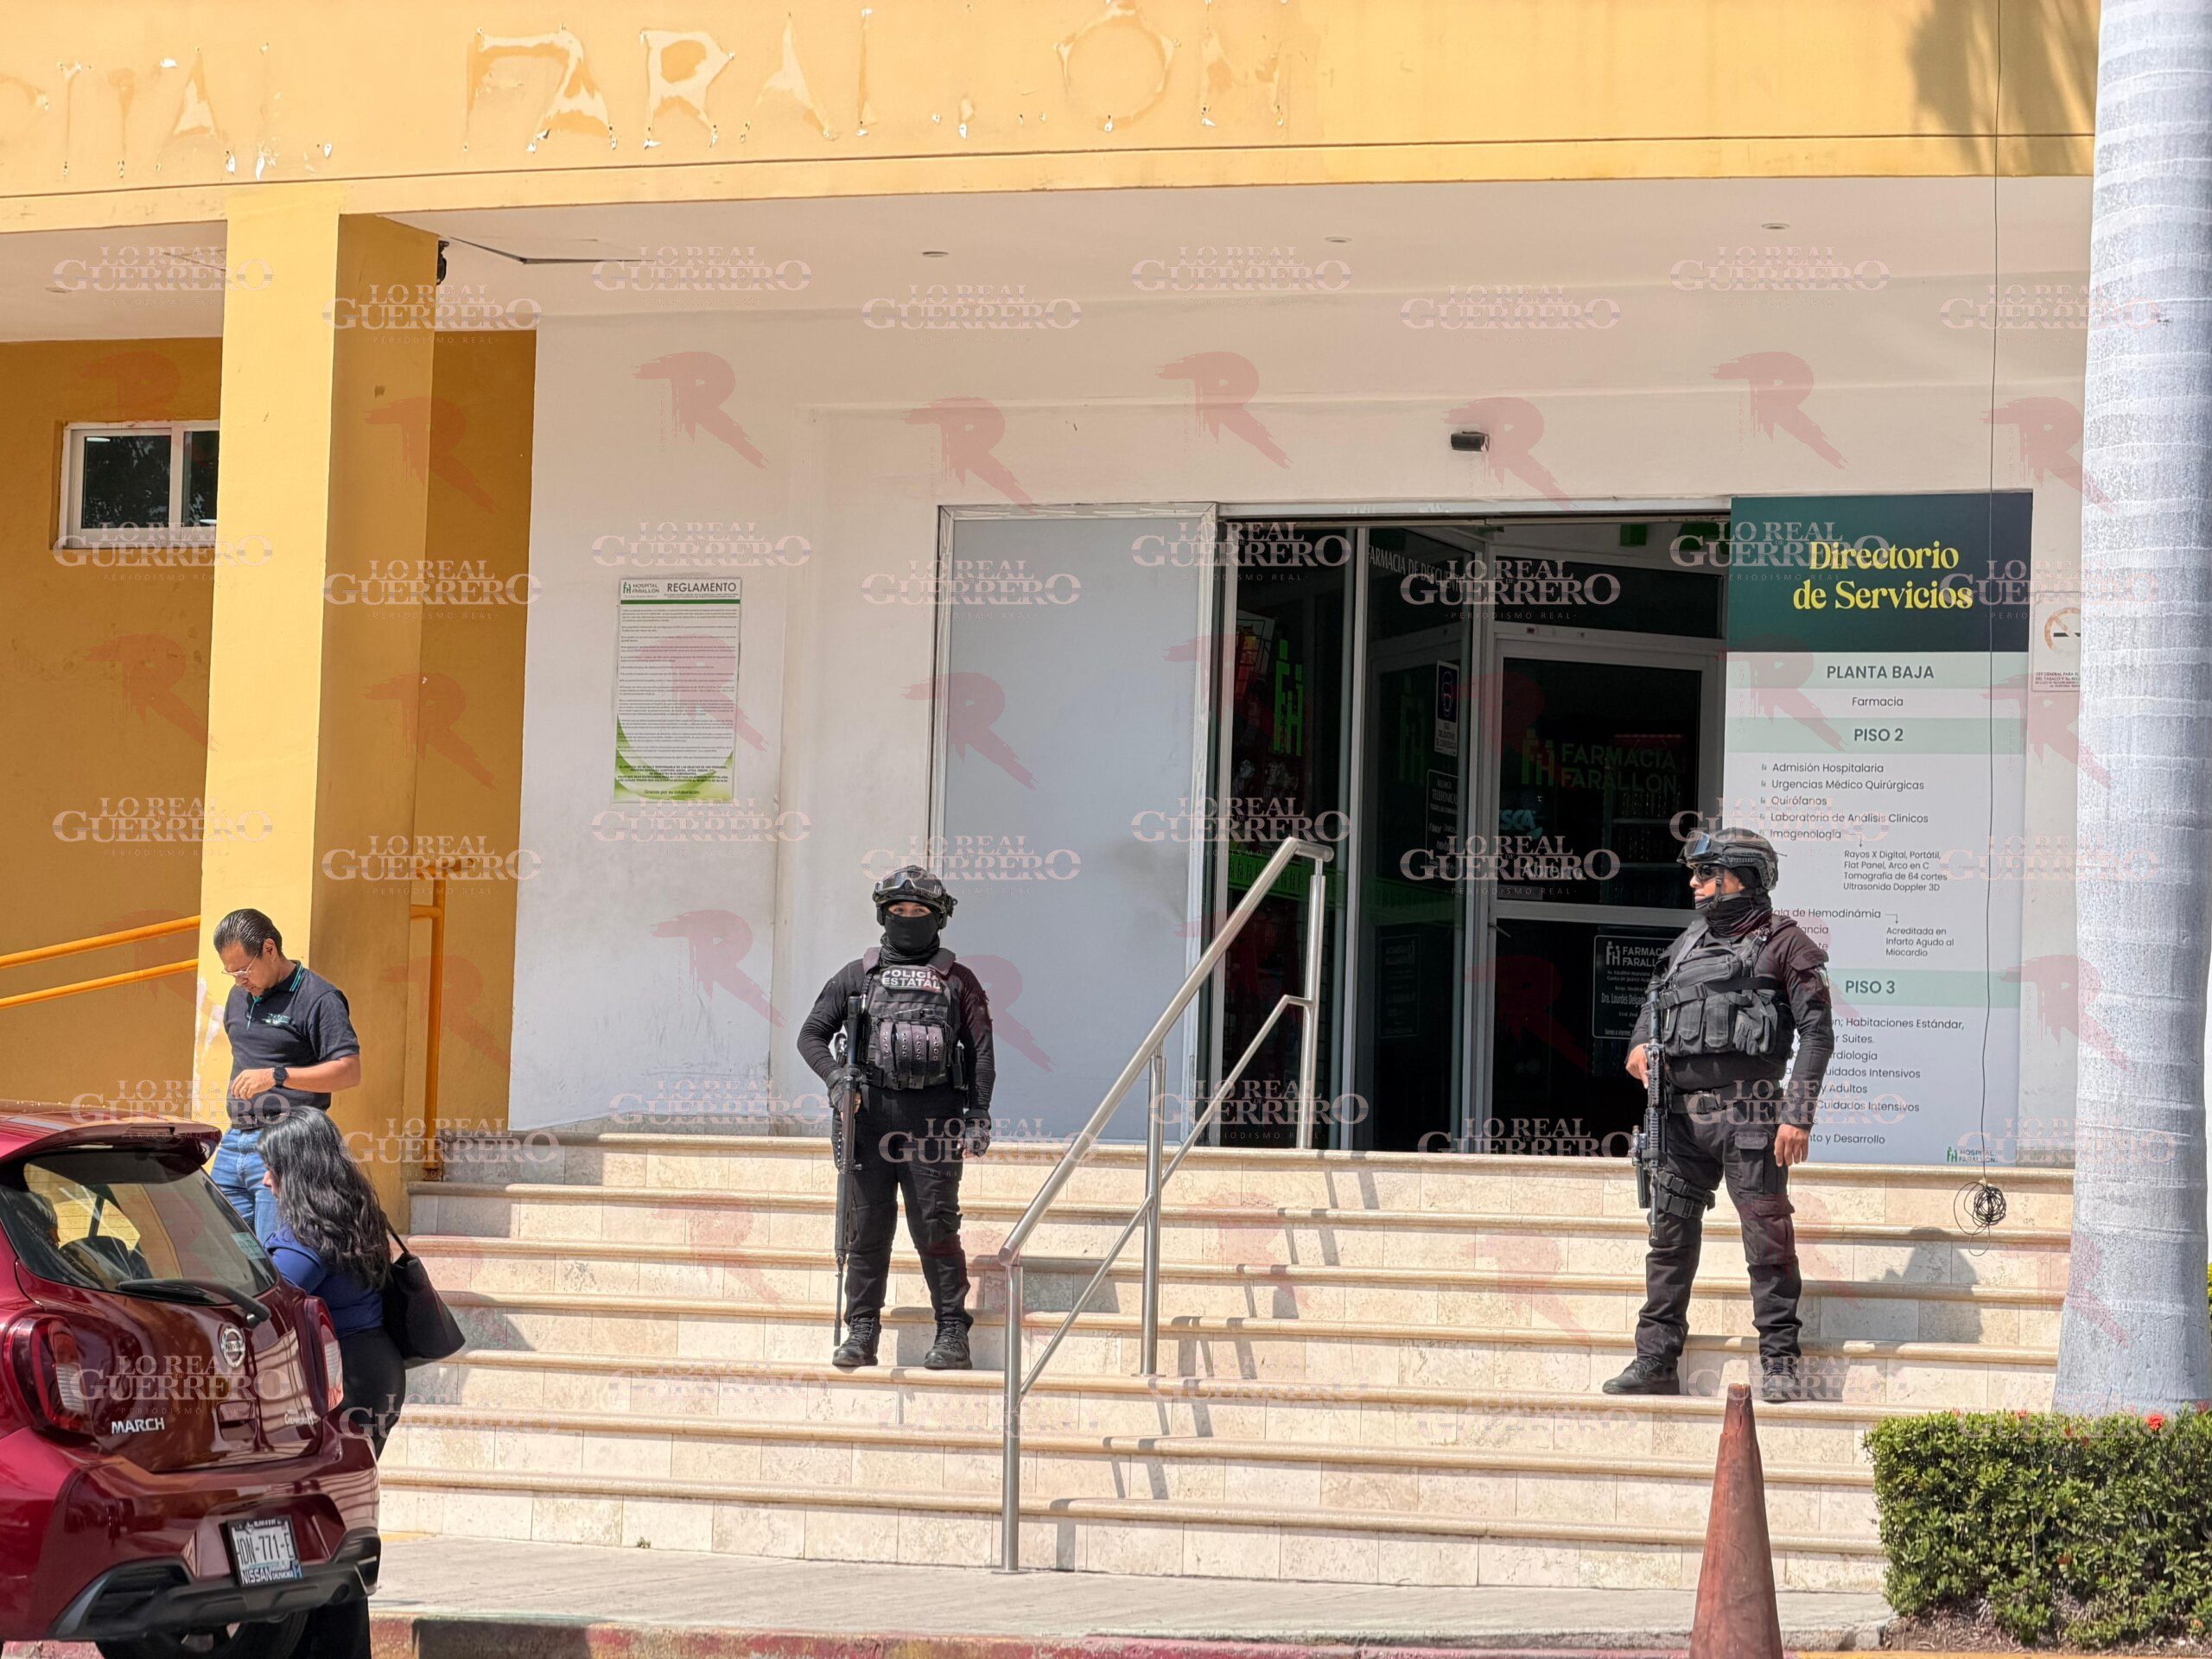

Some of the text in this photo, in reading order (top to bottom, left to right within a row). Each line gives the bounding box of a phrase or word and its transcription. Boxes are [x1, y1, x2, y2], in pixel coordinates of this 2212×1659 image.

[1809, 540, 1960, 569] Directorio
[666, 582, 737, 594] REGLAMENTO
[1793, 579, 1974, 609] de Servicios
[1827, 665, 1935, 679] PLANTA BAJA
[1852, 696, 1904, 708] Farmacia
[1853, 728, 1904, 742] PISO 2
[1561, 743, 1676, 770] FARMACIA
[1772, 763, 1885, 775] Admisión Hospitalaria
[1771, 779, 1924, 792] Urgencias Médico Quirúrgicas
[1770, 796, 1827, 806] Quirófanos
[1770, 812, 1829, 823] Laboratorio
[1832, 813, 1845, 823] de
[1847, 813, 1886, 823] Análisis
[1844, 850, 1941, 861] Rayos X Digital, Portátil,
[1844, 861, 1859, 869] Flat
[1861, 861, 1886, 870] Panel,
[1888, 861, 1908, 870] Arco
[1922, 861, 1929, 870] C
[1894, 872, 1906, 880] de
[1907, 872, 1919, 880] 64
[1920, 873, 1948, 881] cortes
[1843, 882, 1941, 893] Ultrasonido Doppler 3D
[1771, 908, 1881, 918] ala de Hemodinámia
[1885, 927, 1934, 936] Acreditada
[1885, 937, 1914, 946] Infarto
[1916, 938, 1944, 948] Agudo
[1885, 948, 1929, 957] Miocardio
[881, 977, 941, 989] ESTATAL
[1845, 980, 1896, 994] PISO 3
[1846, 1018, 1914, 1028] Habitaciones
[1916, 1019, 1965, 1031] Estándar,
[1841, 1034, 1875, 1044] Suites.
[1825, 1067, 1921, 1078] uidados Intensivos
[1820, 1084, 1868, 1095] y Adultos
[1816, 1100, 1920, 1112] Cuidados Intensivos
[1825, 1135, 1831, 1145] y
[1834, 1134, 1885, 1145] Desarrollo
[111, 1417, 165, 1435] MARCH
[240, 1566, 273, 1585] NISSAN
